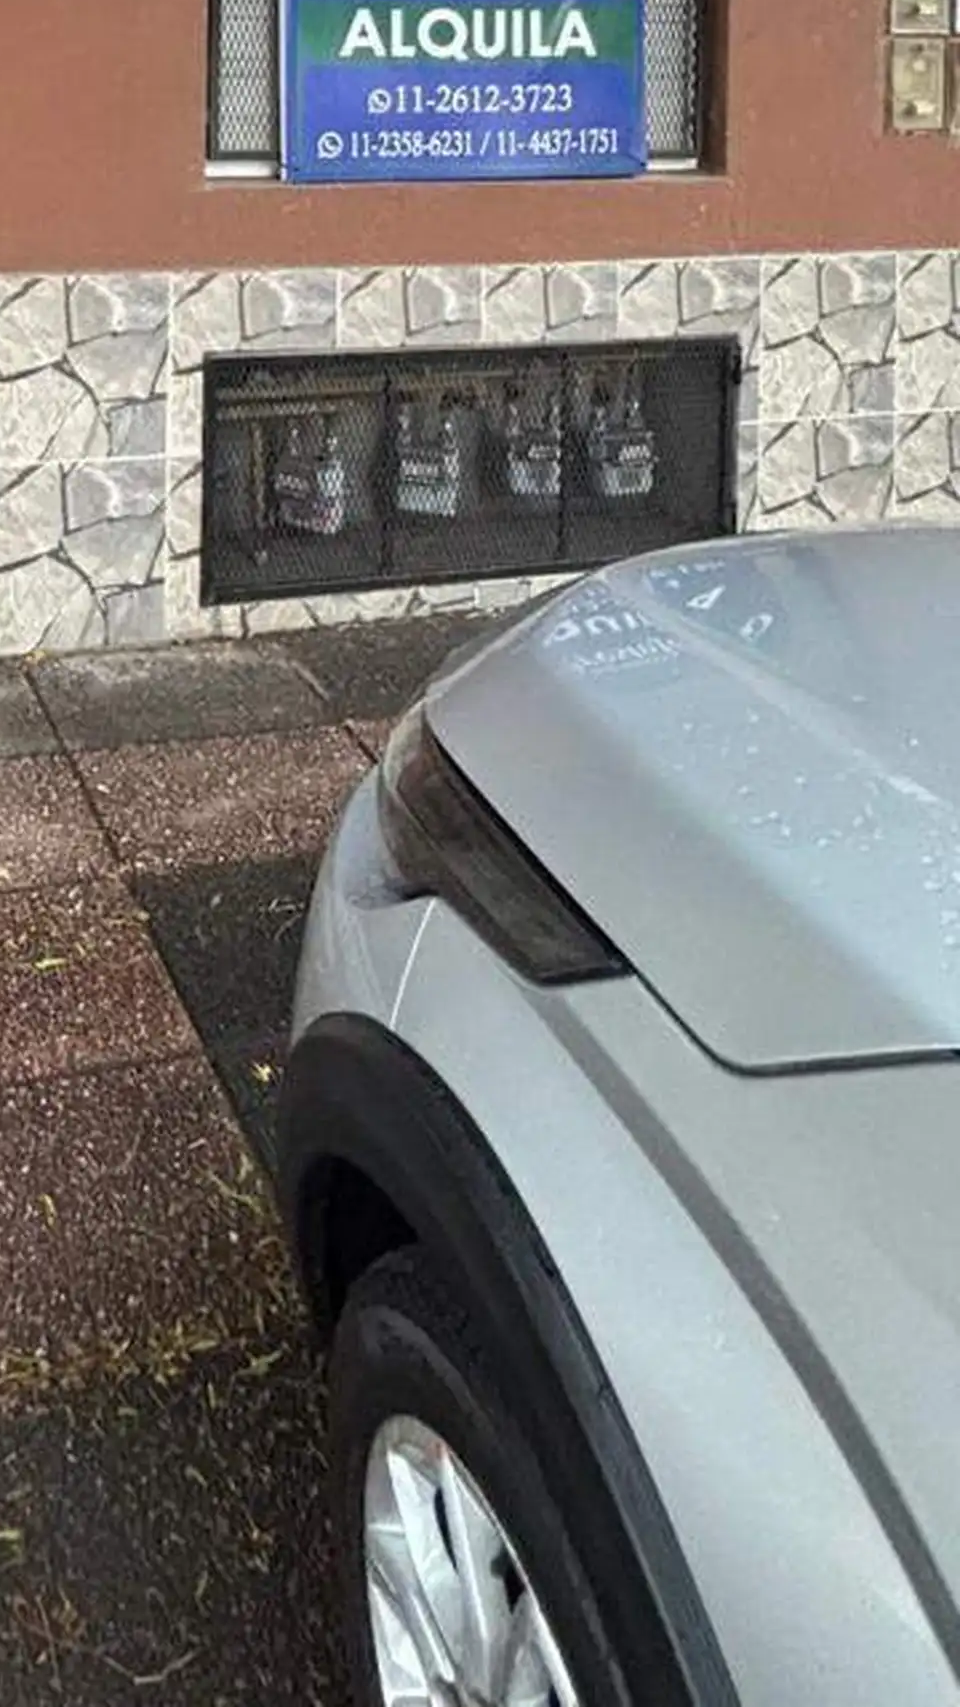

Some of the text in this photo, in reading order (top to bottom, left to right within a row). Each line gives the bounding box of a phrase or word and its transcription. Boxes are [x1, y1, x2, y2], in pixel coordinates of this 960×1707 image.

[338, 7, 598, 61] ALQUILA
[395, 83, 573, 115] 11-2612-3723
[350, 130, 473, 158] 11-2358-6231
